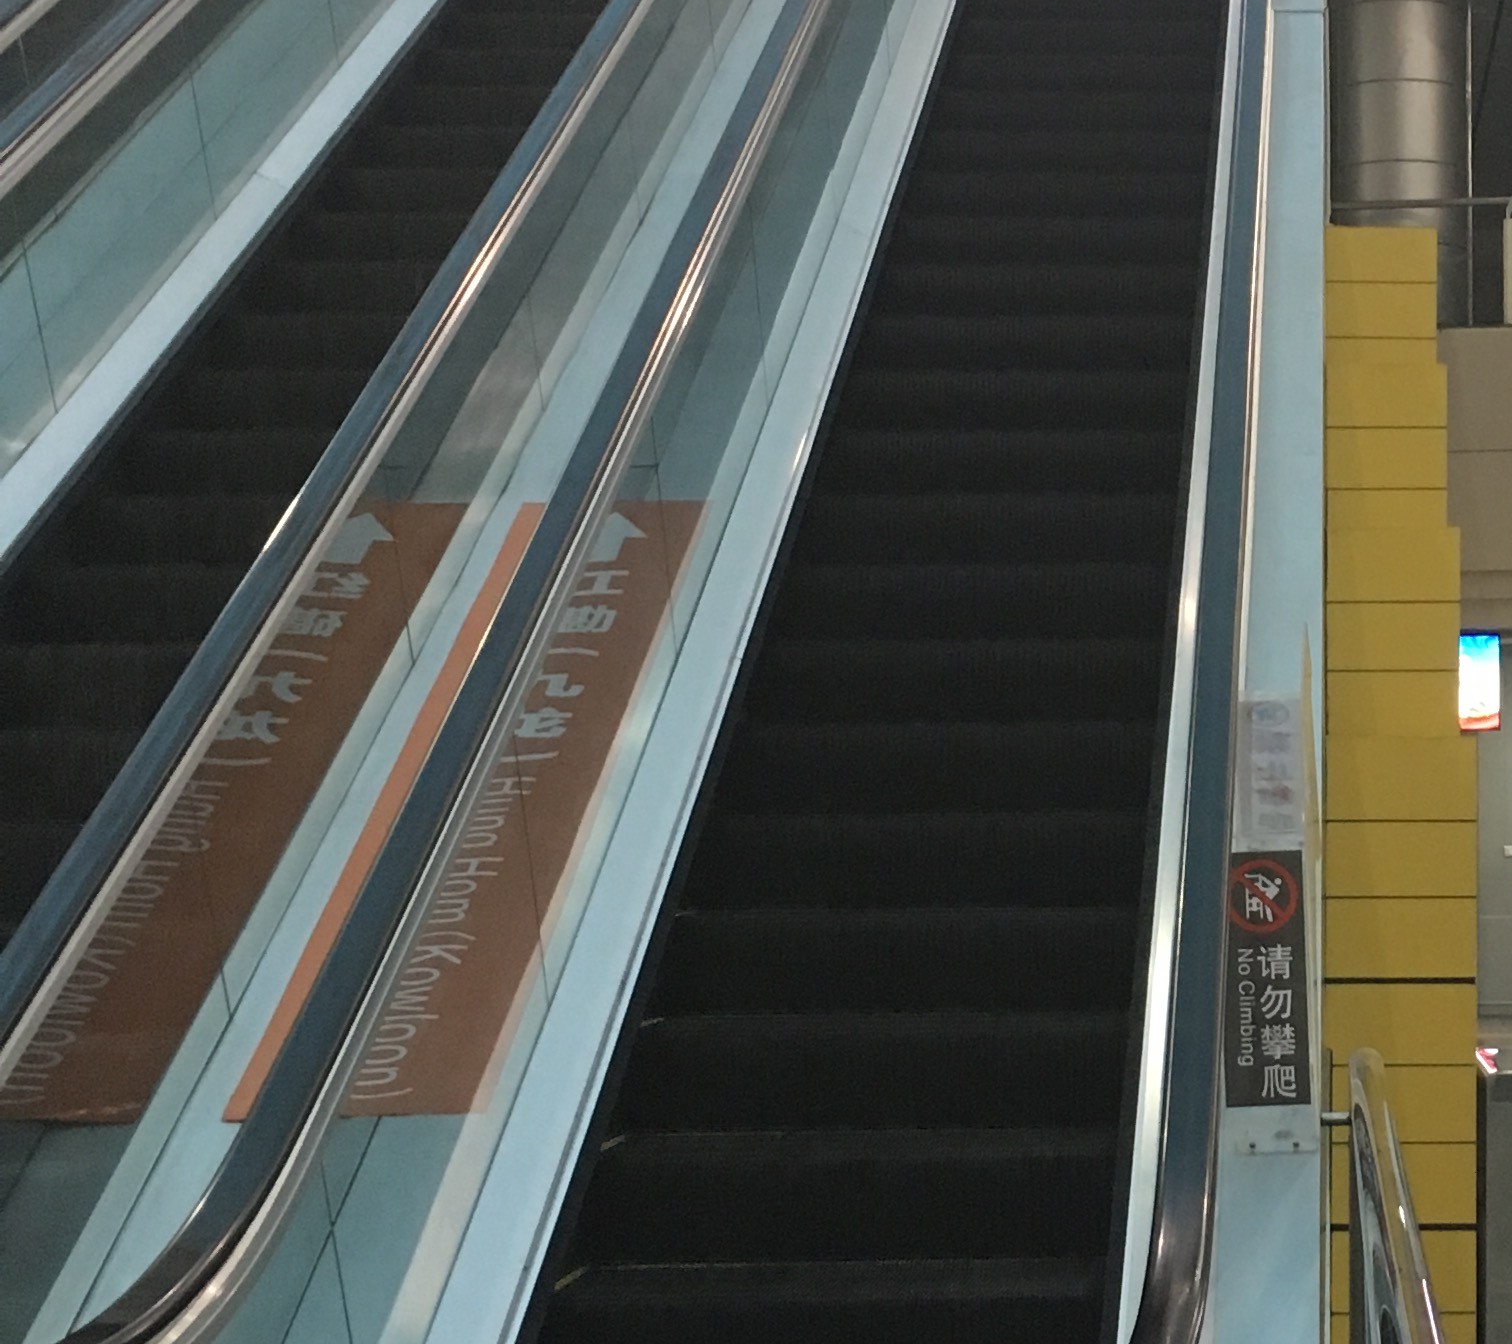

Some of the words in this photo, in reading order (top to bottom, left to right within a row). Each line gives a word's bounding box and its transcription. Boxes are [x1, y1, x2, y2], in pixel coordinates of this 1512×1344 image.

[1237, 948, 1254, 976] No
[1237, 980, 1257, 1067] Climbing
[1256, 944, 1297, 1099] 请勿攀爬
